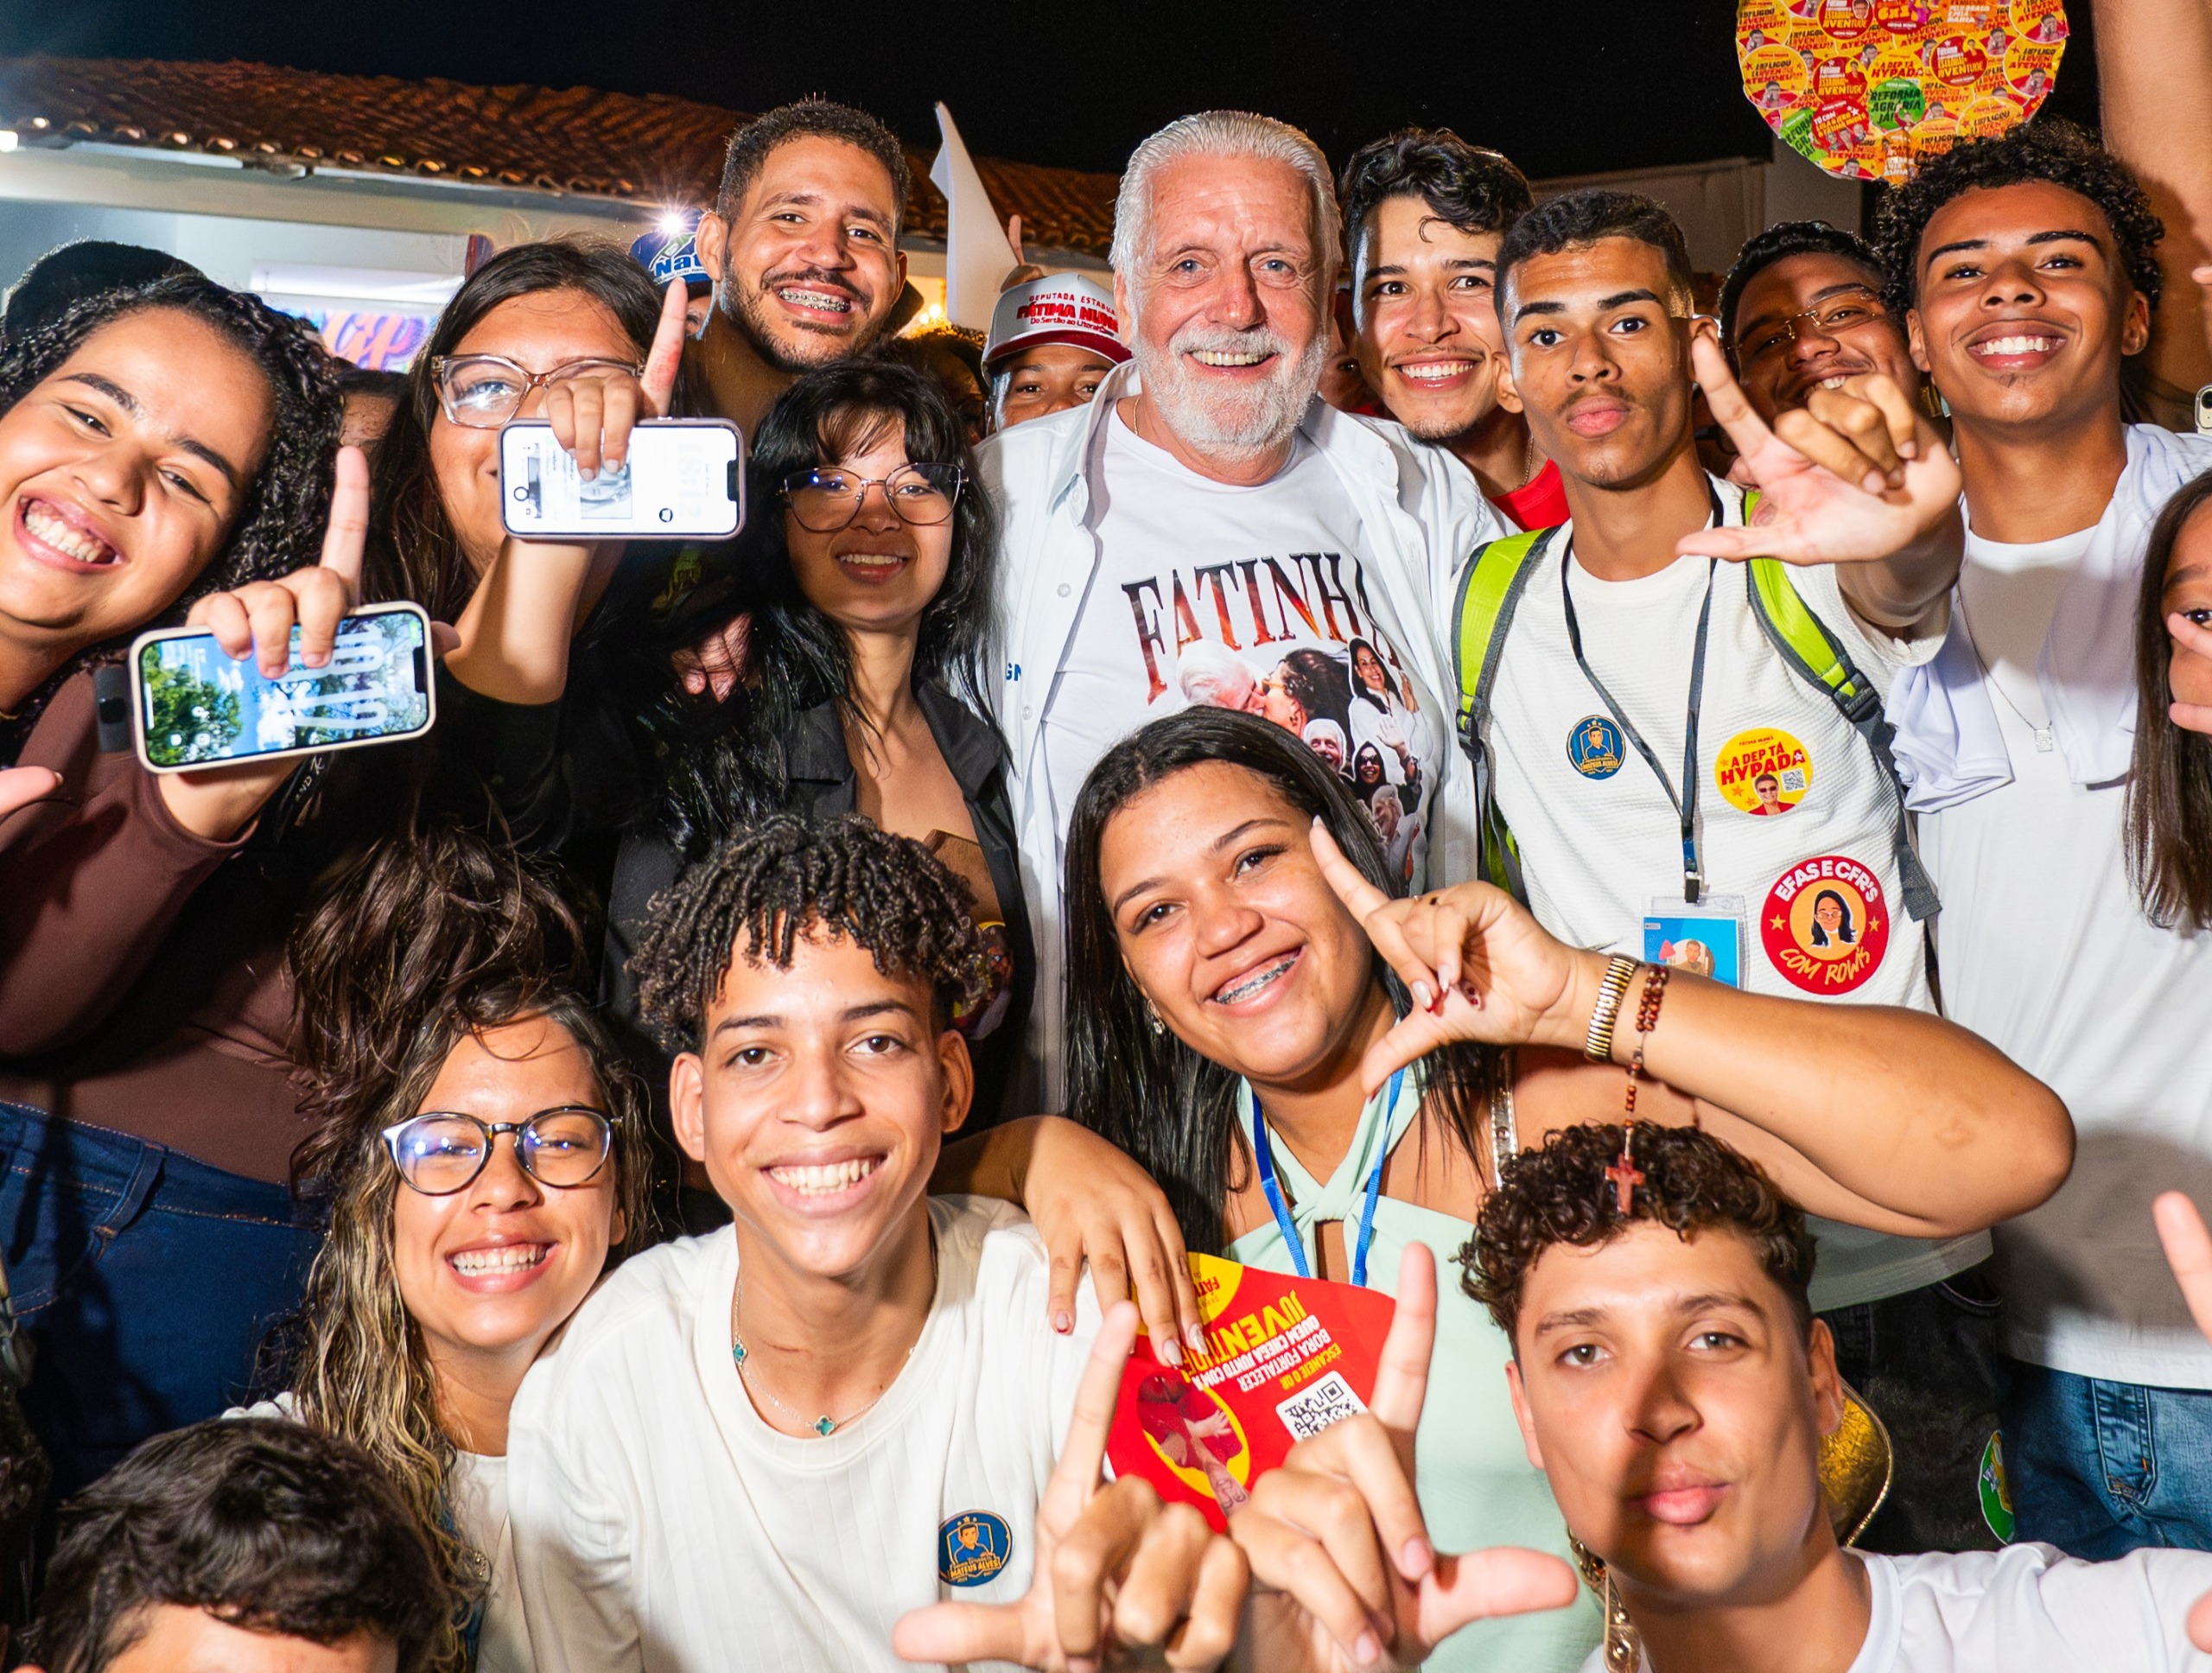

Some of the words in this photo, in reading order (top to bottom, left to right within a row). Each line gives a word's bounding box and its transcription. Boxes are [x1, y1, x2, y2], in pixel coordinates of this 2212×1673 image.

[1029, 292, 1075, 302] DEPUTADA
[1081, 296, 1116, 316] ESTADUA
[1720, 748, 1806, 786] HYPADA
[1732, 756, 1740, 767] A
[1742, 748, 1766, 765] DEP
[1779, 948, 1822, 980] COM
[1285, 1314, 1321, 1345] QUEM
[1298, 1327, 1332, 1358] BORA
[1253, 1333, 1289, 1363] CHEGA
[1301, 1342, 1343, 1380] ESCANEIE
[1201, 1365, 1226, 1388] COM
[1222, 1348, 1258, 1379] JUNTO
[1236, 1351, 1302, 1393] FORTALECER
[1291, 1370, 1302, 1384] O
[1191, 1375, 1205, 1391] A
[1279, 1377, 1296, 1390] QR
